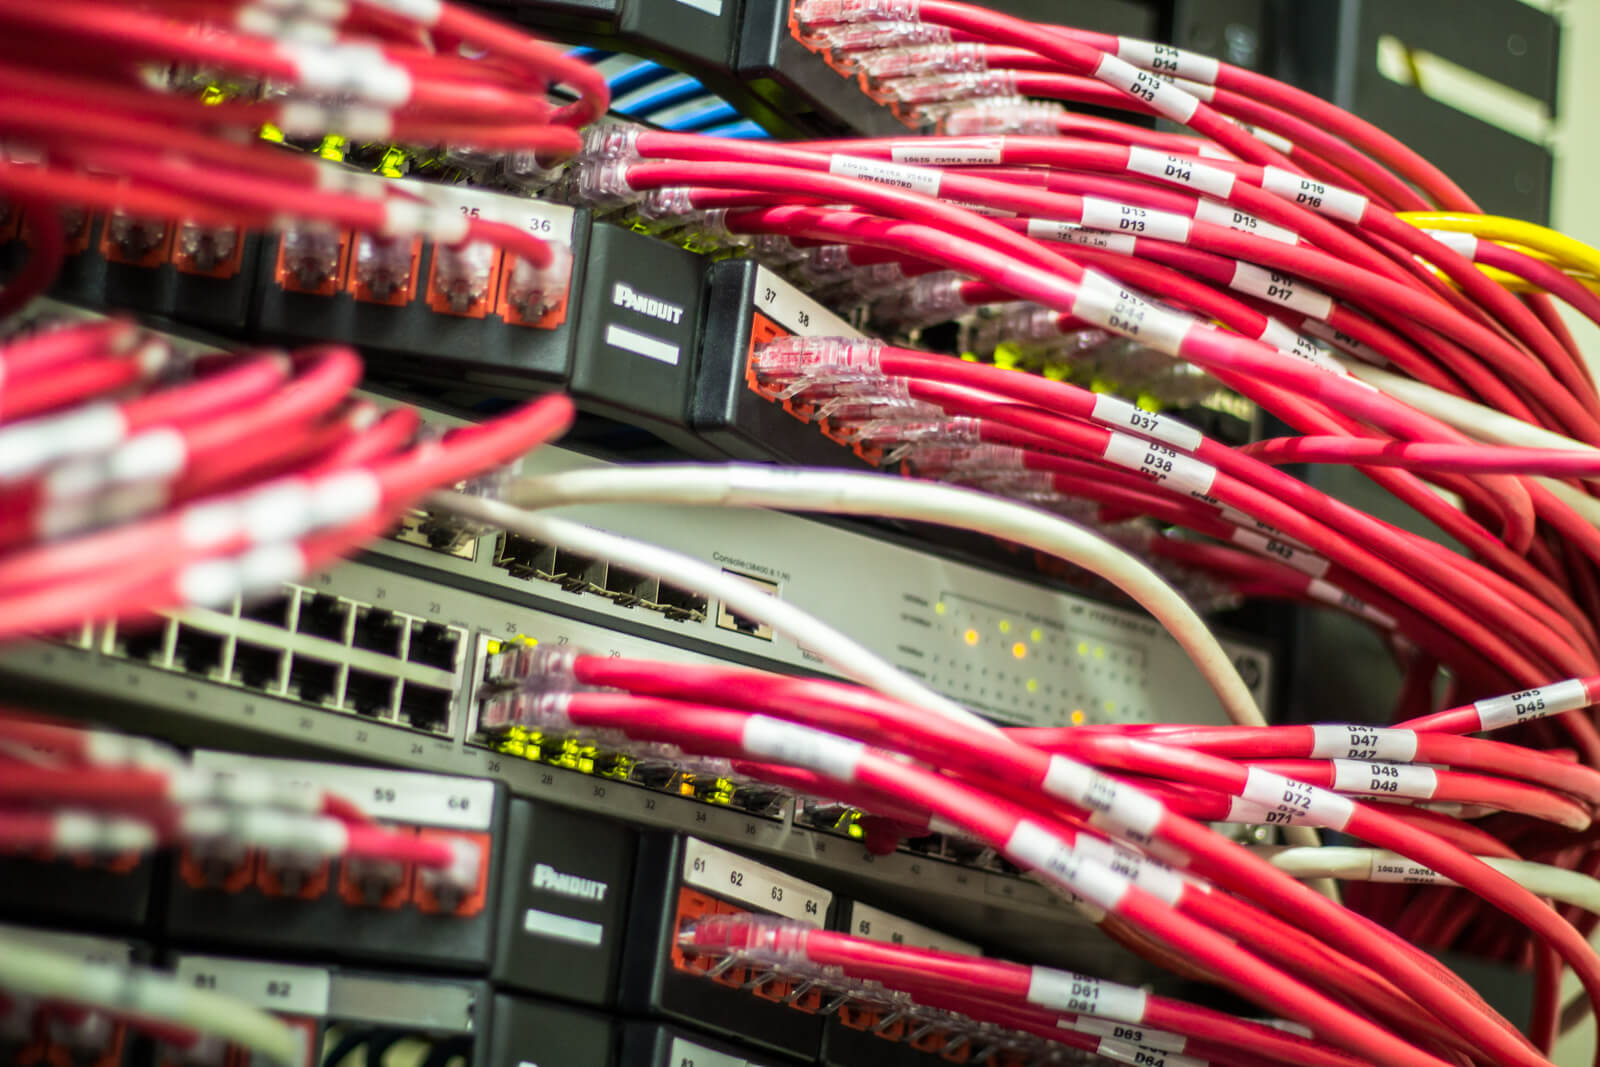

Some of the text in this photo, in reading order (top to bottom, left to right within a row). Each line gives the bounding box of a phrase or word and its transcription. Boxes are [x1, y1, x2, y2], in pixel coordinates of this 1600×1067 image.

[1151, 57, 1178, 71] D14
[1129, 82, 1155, 102] D13
[1164, 164, 1192, 182] D14
[1296, 193, 1323, 208] D16
[530, 218, 551, 232] 36
[1119, 218, 1145, 232] D13
[1232, 212, 1258, 228] D15
[1267, 285, 1293, 301] D17
[613, 283, 683, 325] PANDUIT
[764, 287, 809, 328] 37 38
[1109, 315, 1139, 334] D44
[1130, 413, 1159, 431] D37
[1143, 453, 1173, 473] D38
[506, 622, 517, 633] 25
[1515, 699, 1545, 715] D45
[1350, 734, 1378, 747] D47
[412, 743, 423, 755] 24
[1371, 764, 1399, 777] D48
[488, 760, 500, 773] 26
[541, 773, 553, 785] 28
[594, 786, 606, 798] 30
[645, 799, 656, 811] 32
[1370, 779, 1398, 792] D48
[373, 788, 395, 803] 59
[1282, 790, 1312, 809] D72
[1266, 811, 1293, 824] D71
[531, 863, 608, 901] PANDUIT
[694, 858, 818, 916] 61 62 63 64
[859, 920, 871, 935] 65
[1072, 983, 1099, 999] D61
[1113, 1026, 1143, 1041] D63
